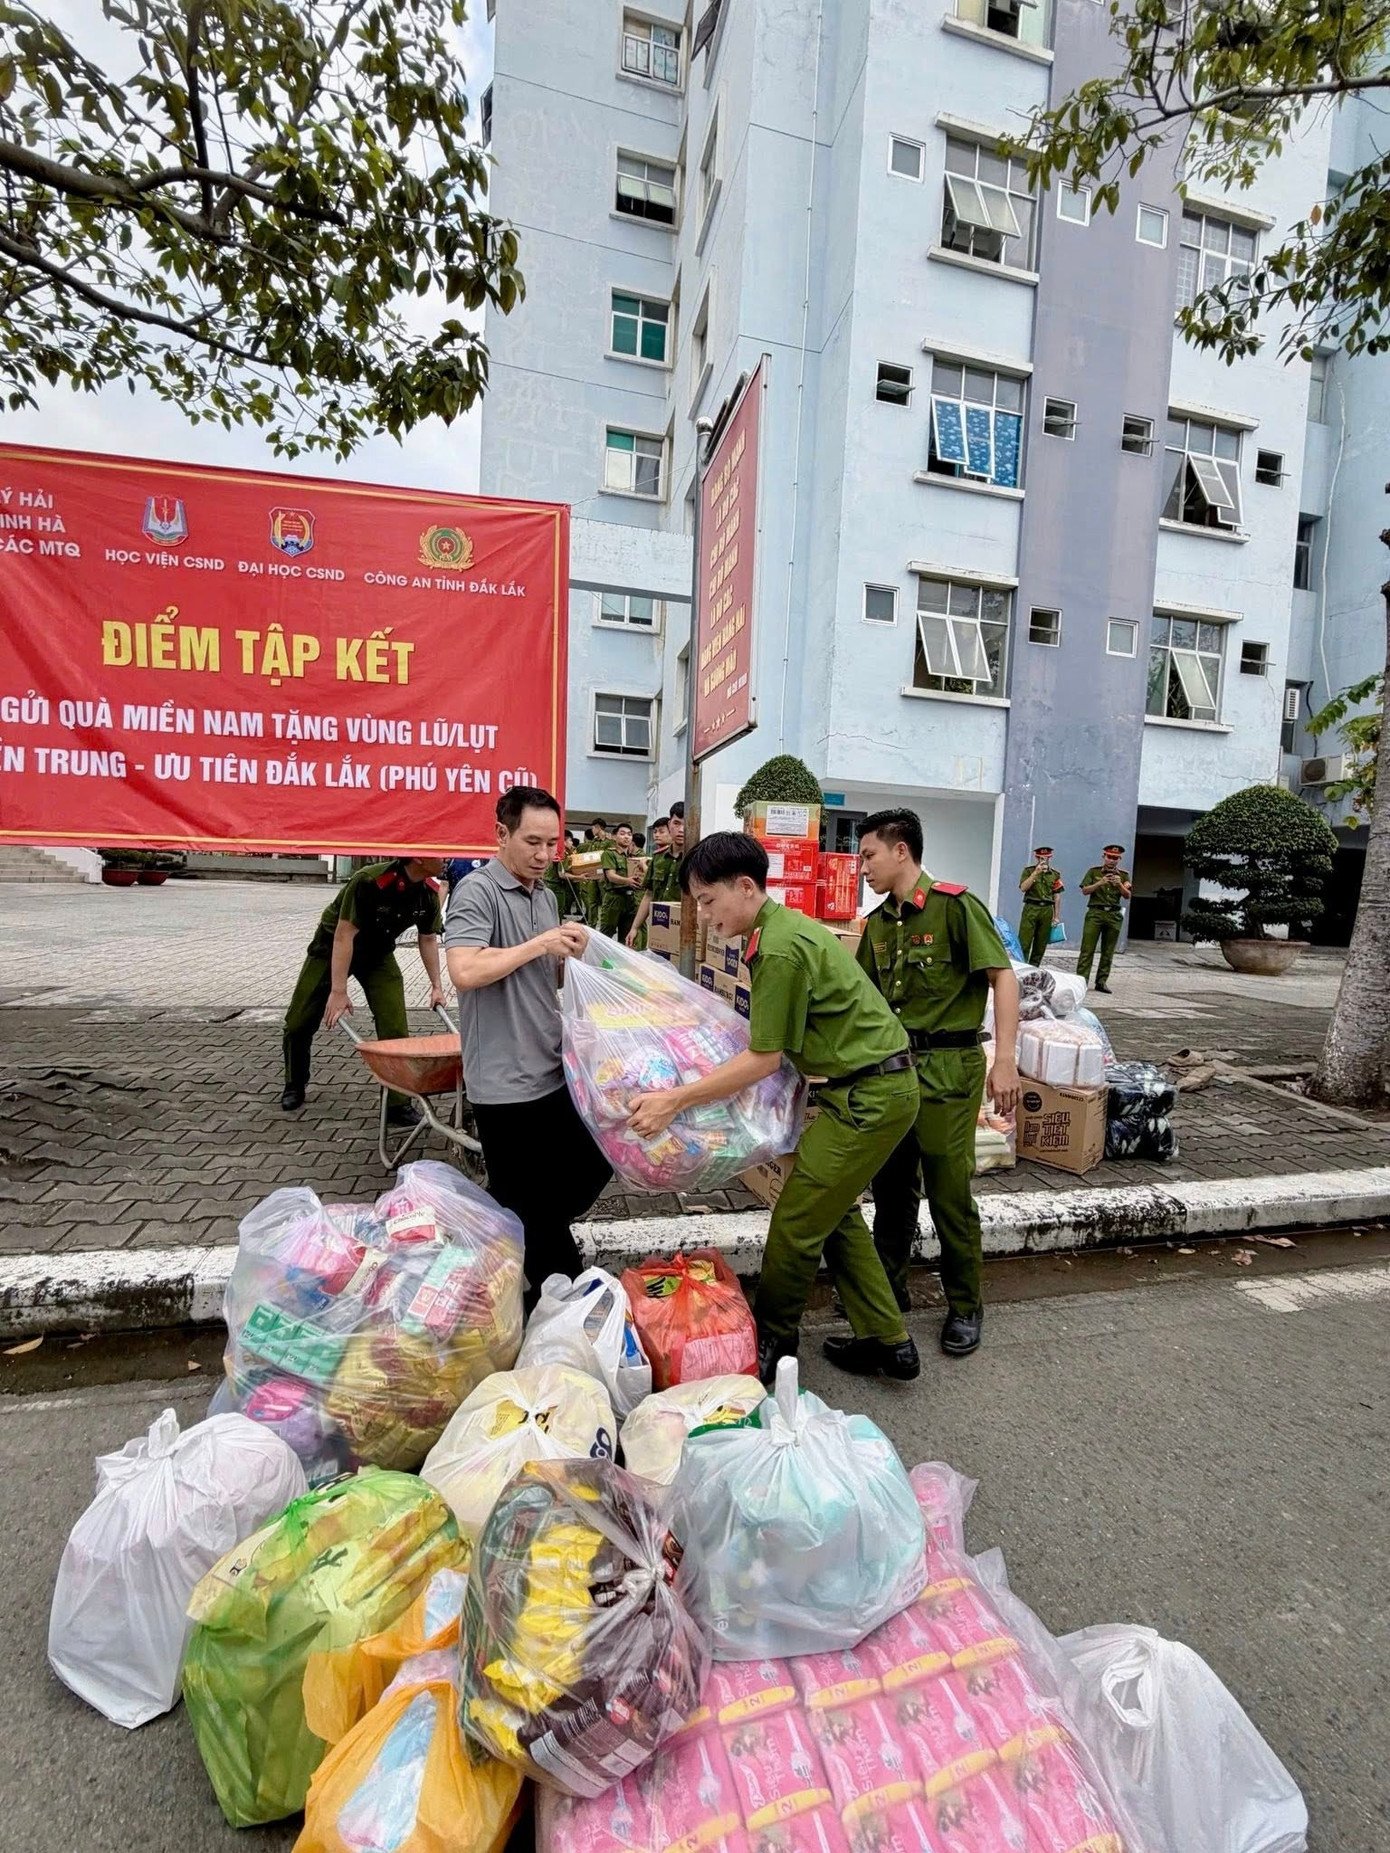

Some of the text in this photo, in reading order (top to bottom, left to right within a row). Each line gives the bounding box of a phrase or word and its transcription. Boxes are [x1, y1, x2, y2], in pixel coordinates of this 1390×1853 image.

[19, 488, 54, 509] HẢI
[38, 514, 66, 533] HÀ
[39, 539, 81, 558] MTQ
[105, 549, 225, 571] HỌC VIỆN CSND
[238, 561, 345, 581] ĐẠI HỌC CSND
[364, 571, 526, 597] CÔNG AN TỈNH ĐẮK LẮK
[101, 605, 415, 686] ĐIỂM TẬP KẾT
[1, 689, 499, 753] GỬI QUÀ MIỀN NAM TẶNG VÙNG LŨ/LỤT
[34, 747, 127, 778] TRUNG
[154, 752, 191, 781] ƯU
[199, 753, 258, 784] TIÊN
[265, 751, 317, 786] ĐẮK
[325, 754, 371, 789] LẮK
[380, 762, 437, 792] (PHÚ
[445, 764, 490, 793] YÊN
